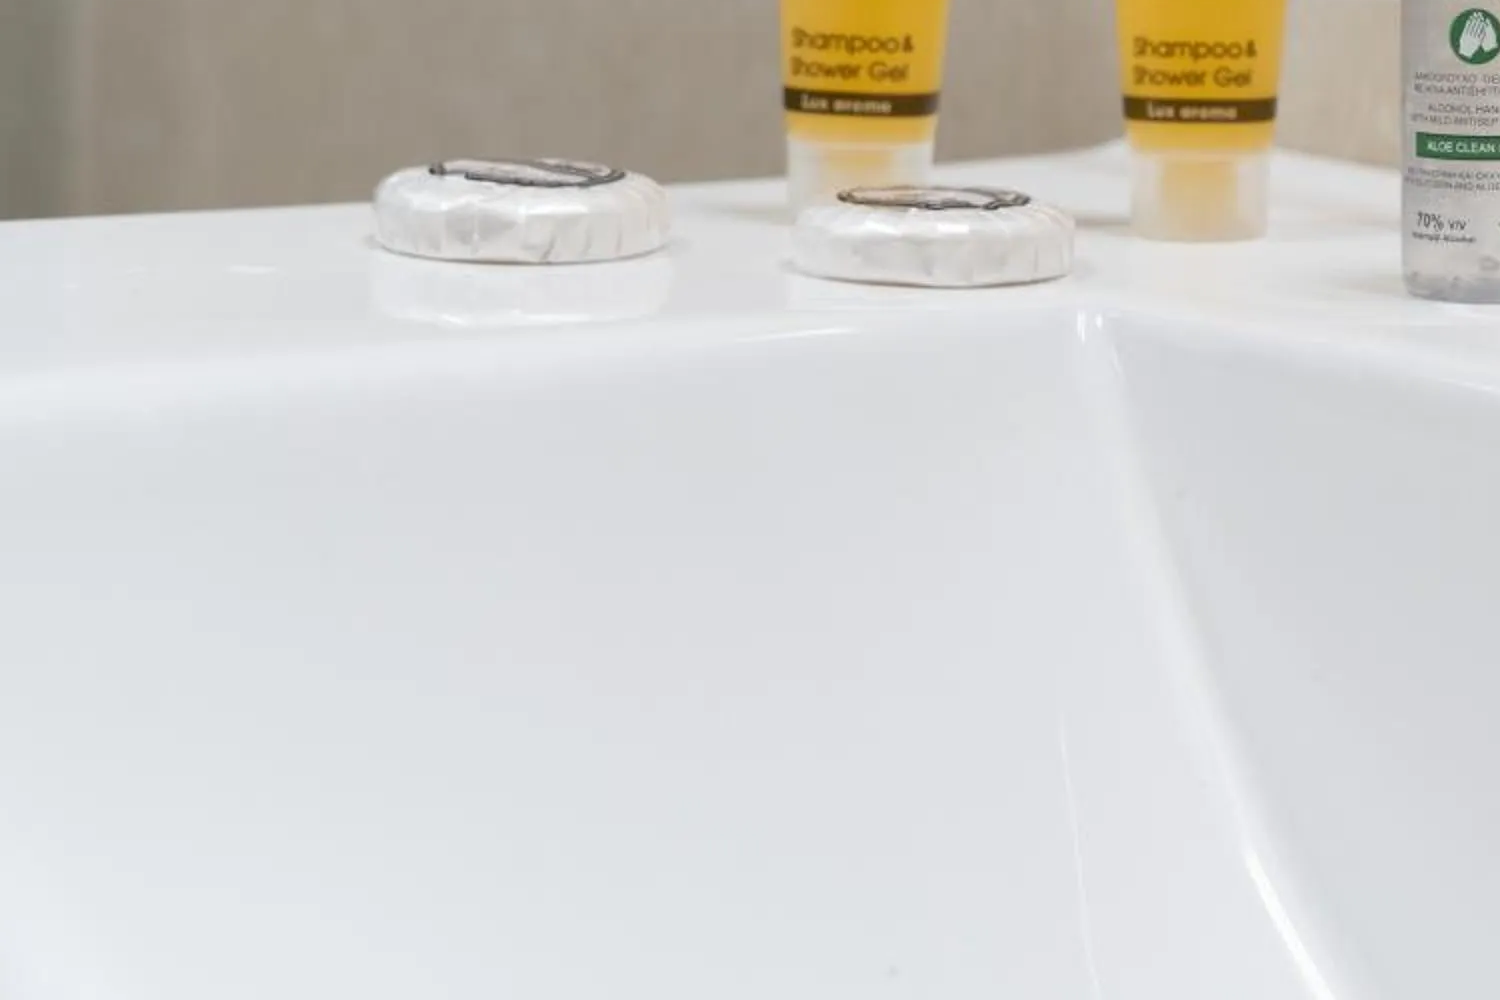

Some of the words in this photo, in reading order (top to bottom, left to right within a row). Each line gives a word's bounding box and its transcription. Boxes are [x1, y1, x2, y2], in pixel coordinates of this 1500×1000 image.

[790, 26, 900, 56] Shampoo
[1132, 35, 1244, 62] Shampoo
[790, 56, 862, 80] Shower
[868, 60, 911, 82] Gel
[1132, 65, 1206, 87] Shower
[1213, 66, 1253, 87] Gel
[1427, 141, 1453, 153] ALOE
[1455, 141, 1496, 154] CLEAN
[1416, 211, 1444, 231] 70%
